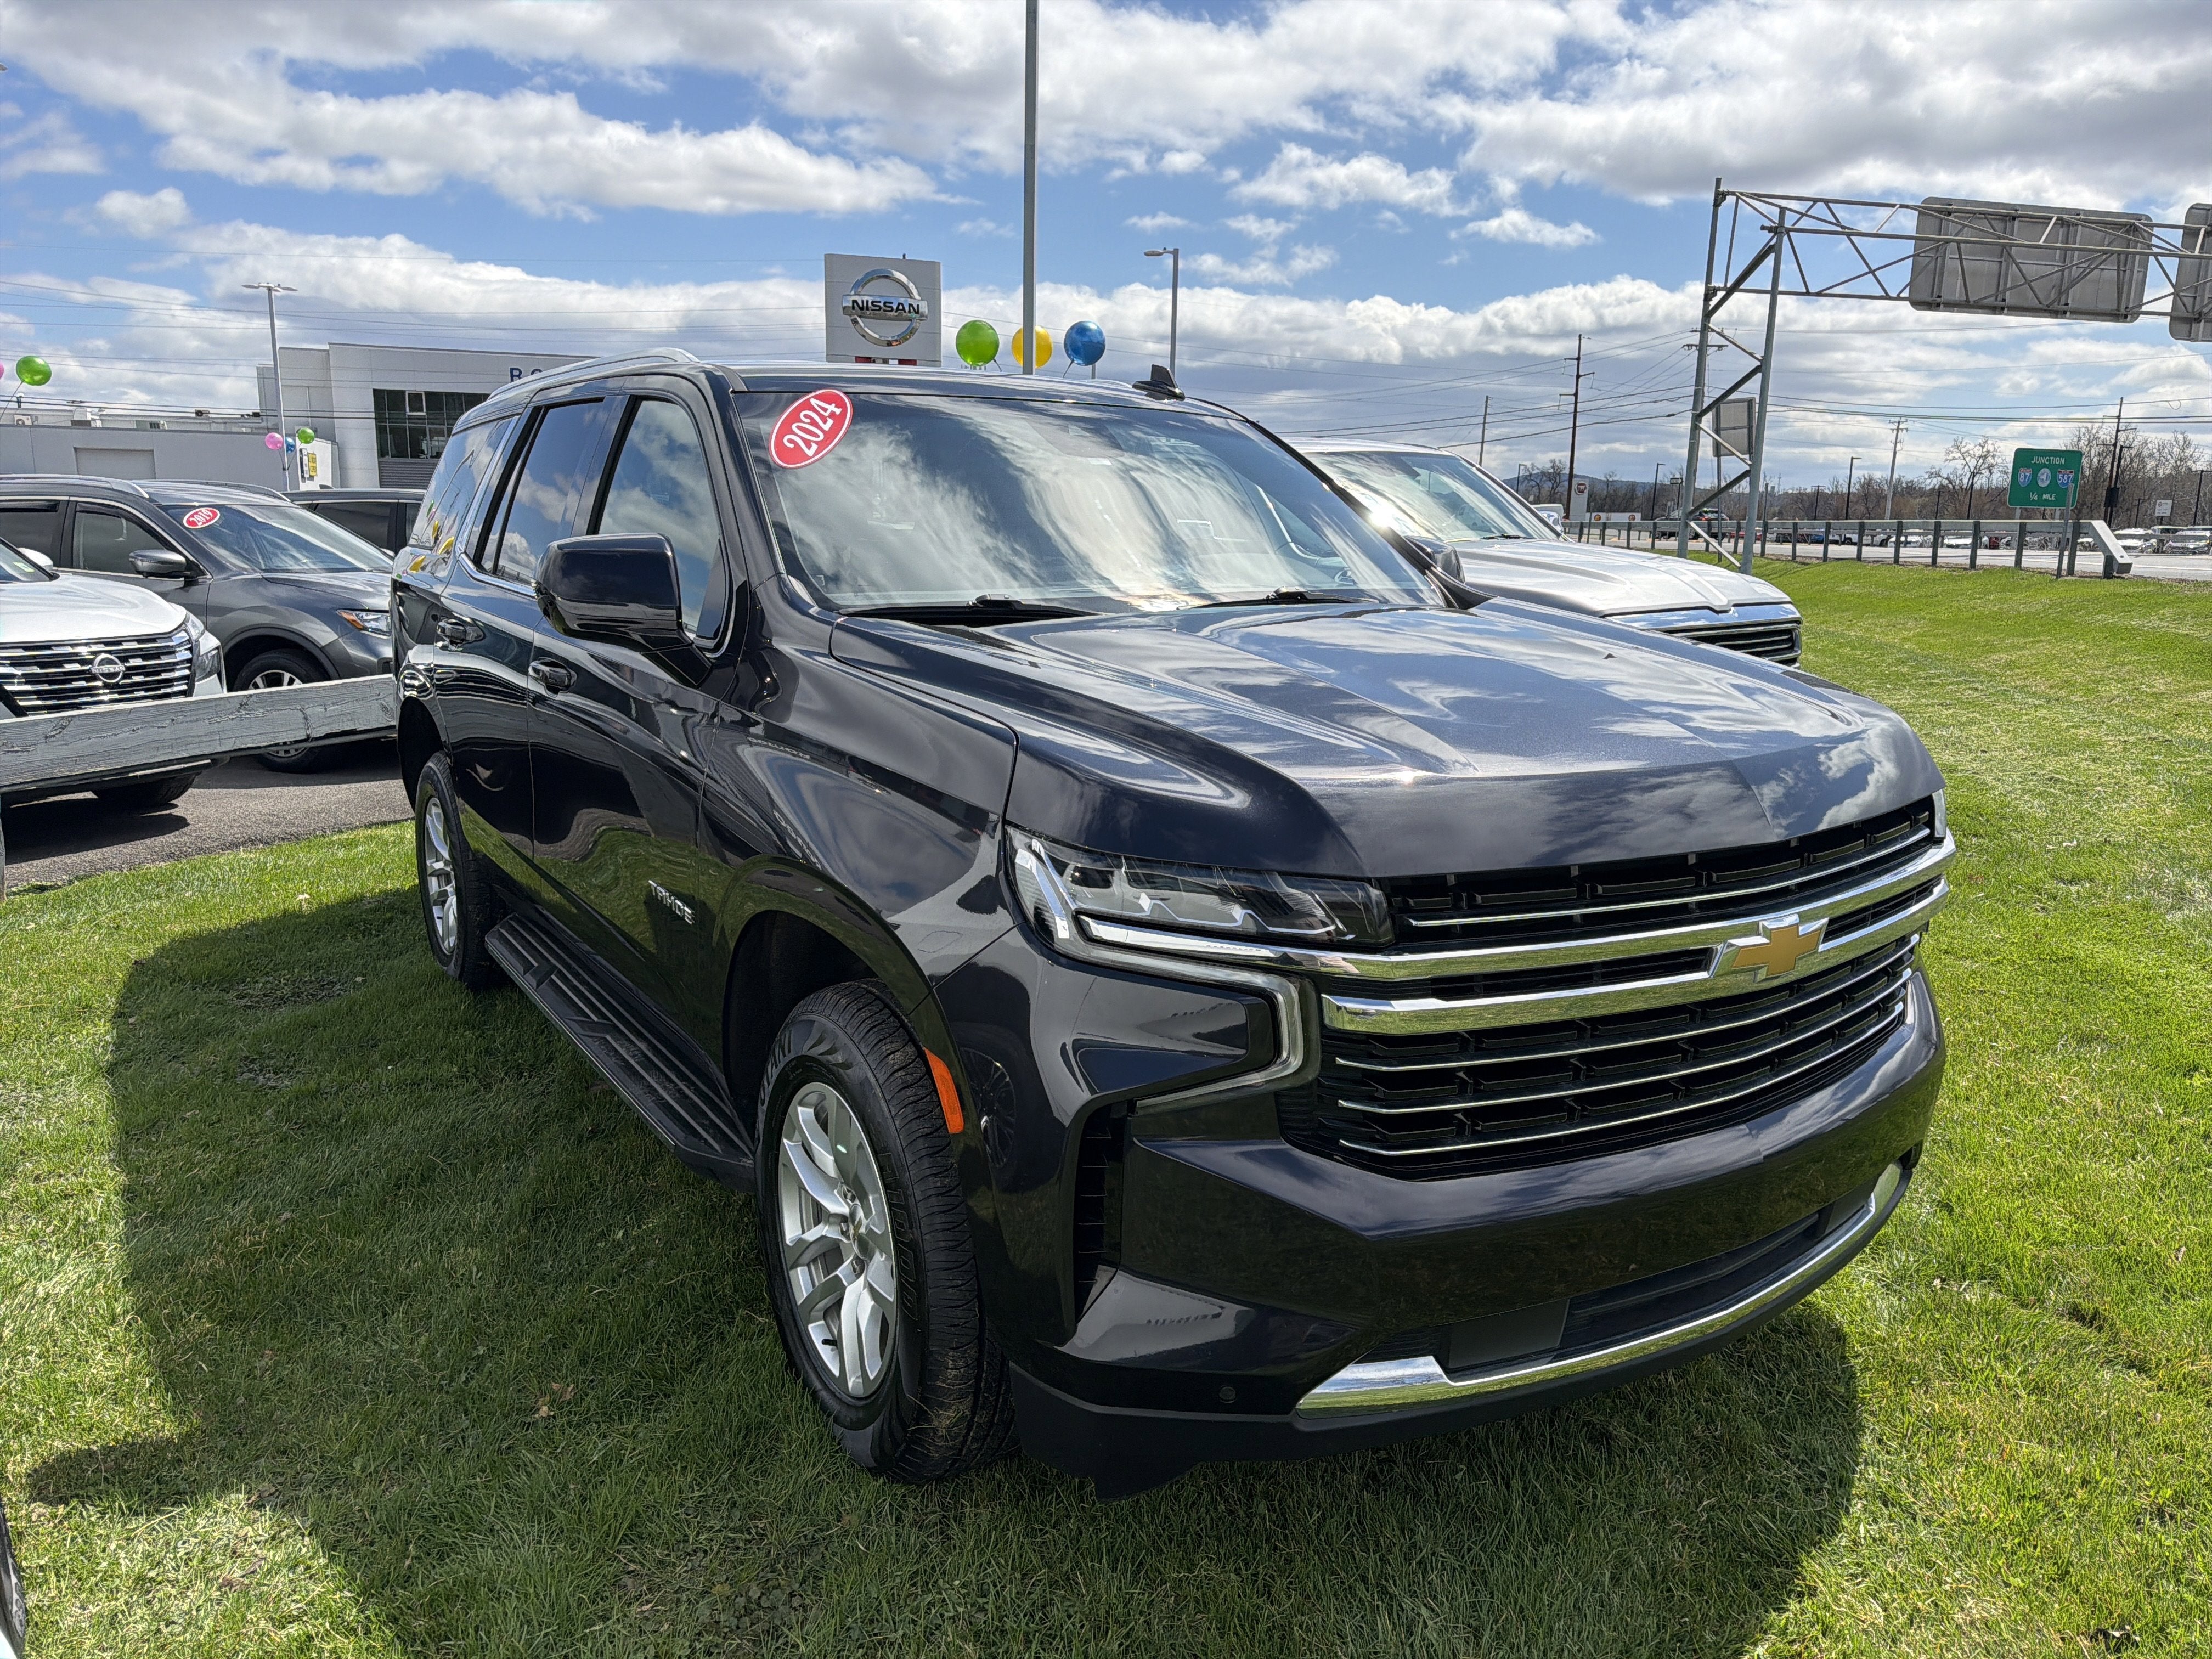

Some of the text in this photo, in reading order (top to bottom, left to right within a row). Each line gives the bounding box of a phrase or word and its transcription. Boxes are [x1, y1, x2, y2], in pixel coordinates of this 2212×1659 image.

[851, 299, 920, 315] NISSAN
[783, 398, 842, 457] 2024
[2031, 456, 2065, 465] JUNCTION
[2019, 472, 2030, 482] 87
[2058, 474, 2073, 483] 587
[189, 510, 213, 526] 2019
[648, 879, 695, 925] TAHOE
